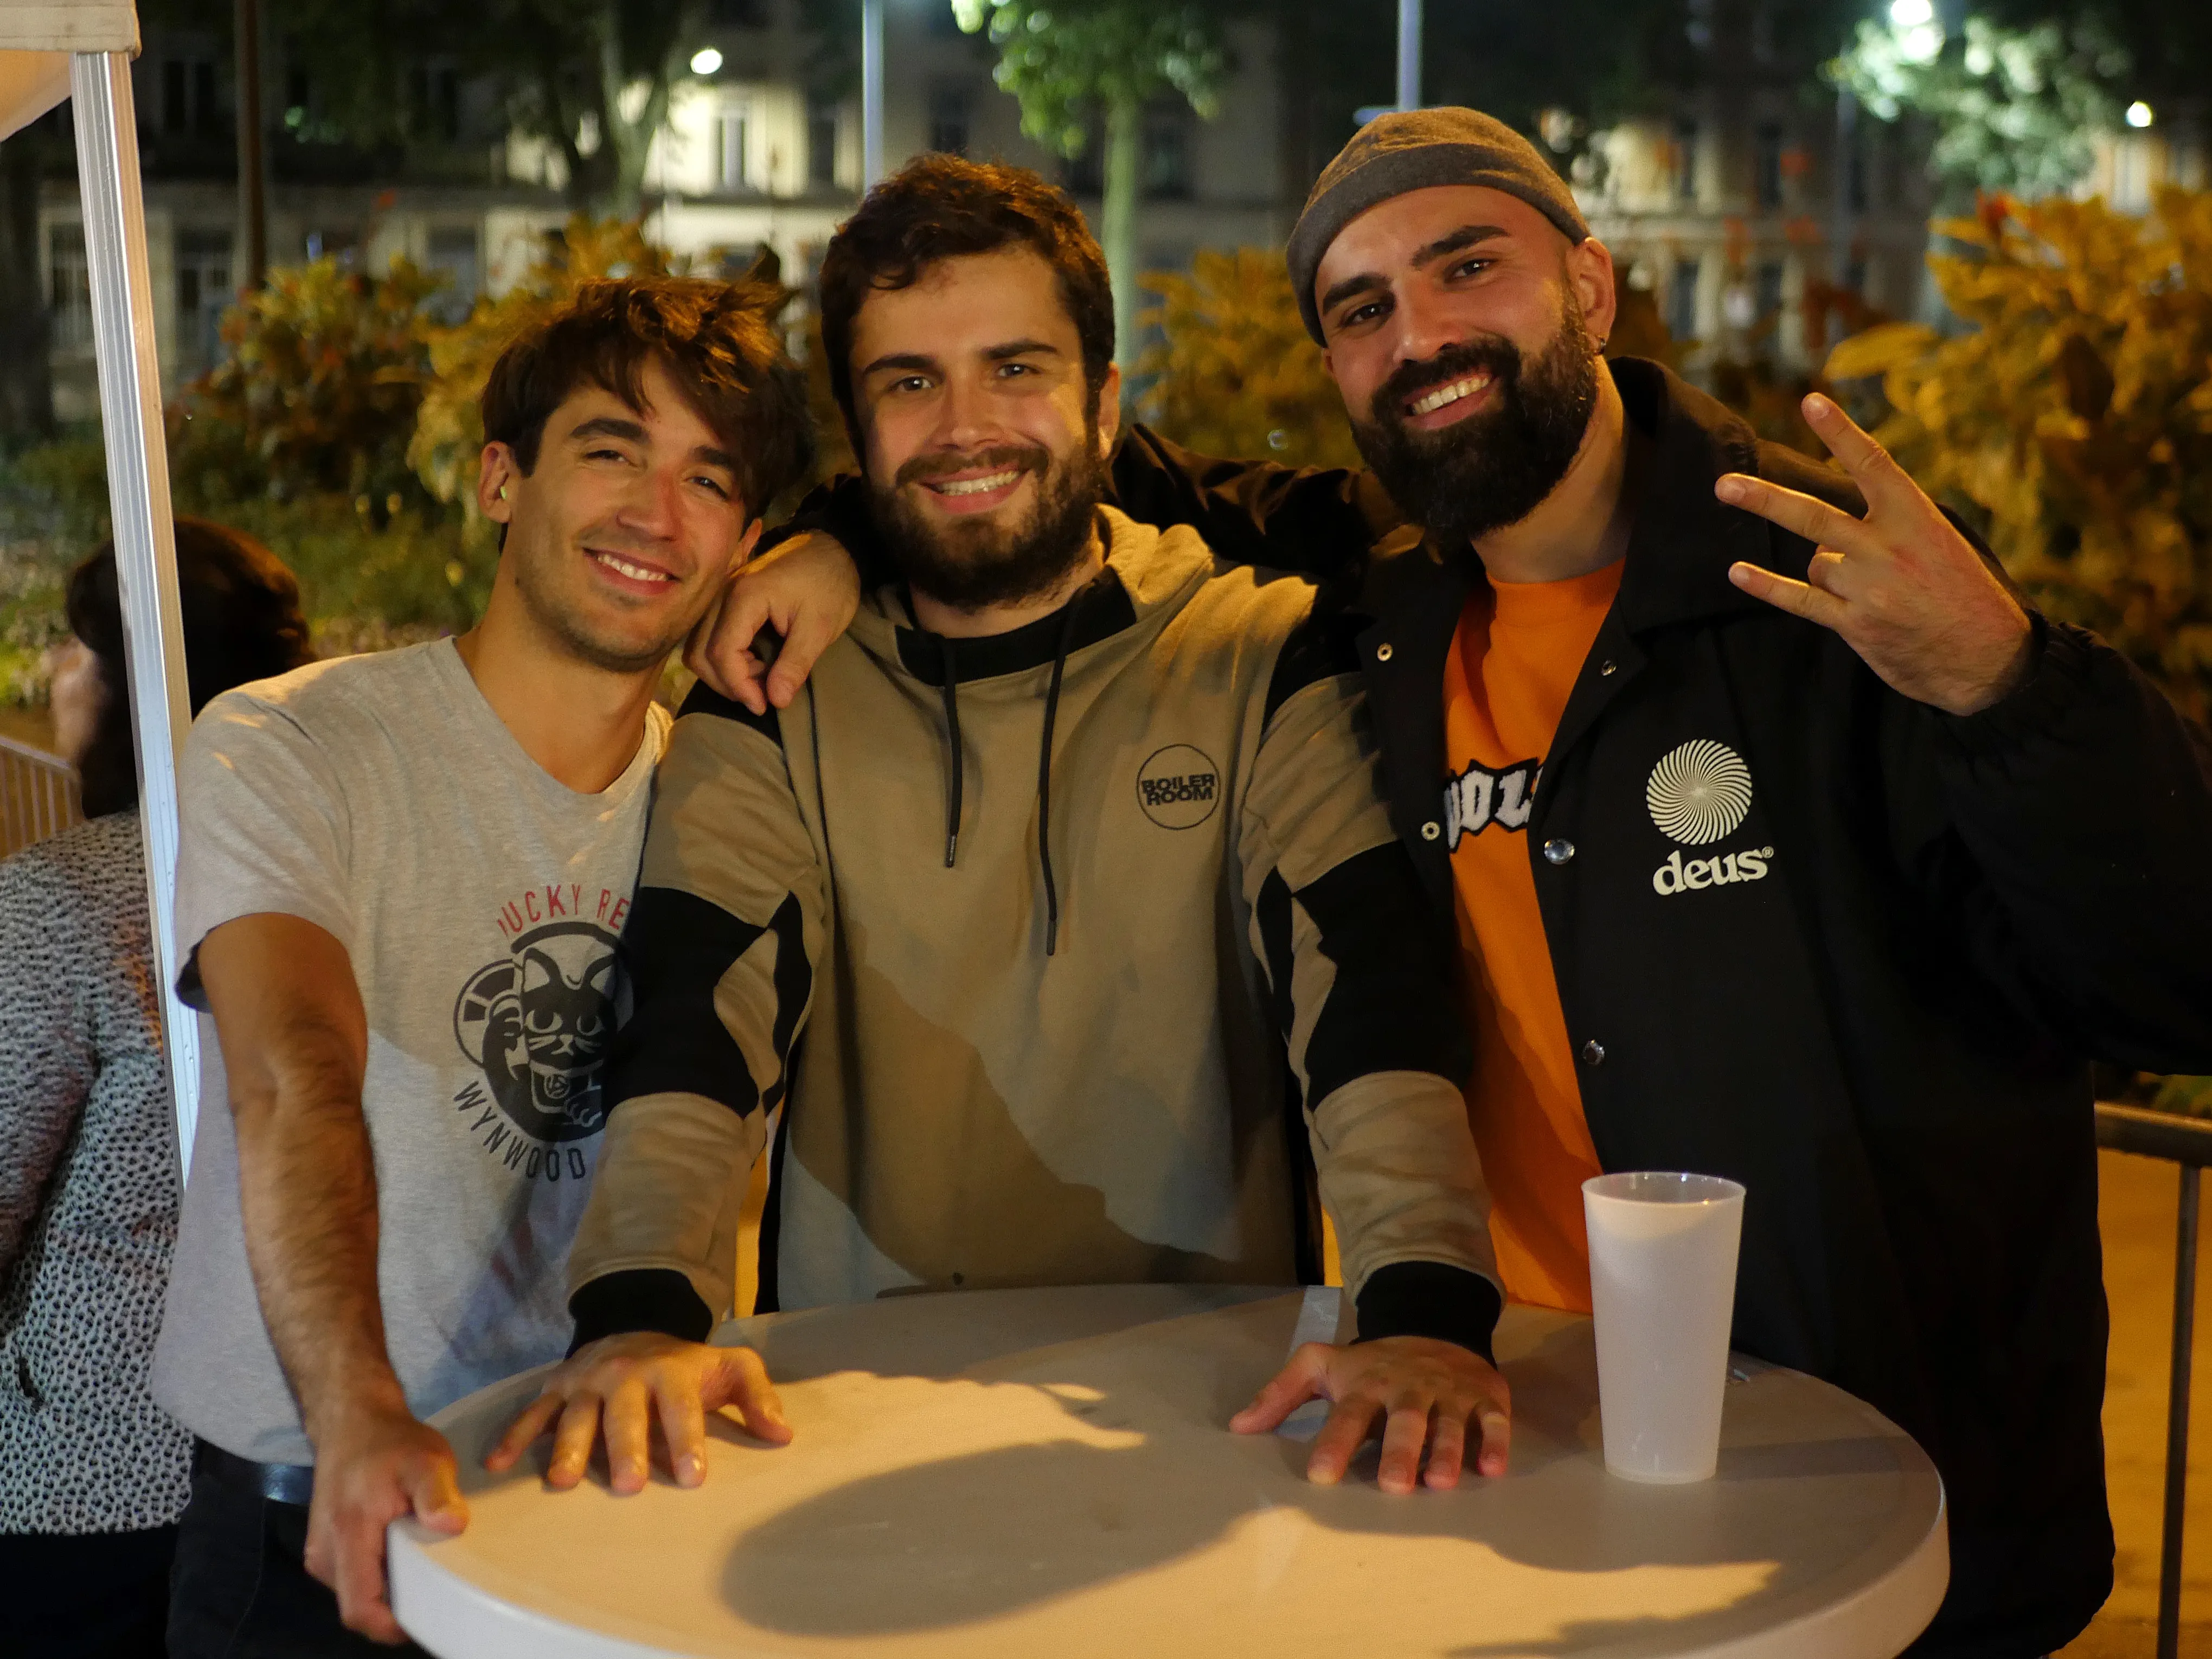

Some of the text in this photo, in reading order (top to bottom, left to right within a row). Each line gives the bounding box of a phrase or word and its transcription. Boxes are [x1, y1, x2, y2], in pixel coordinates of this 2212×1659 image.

[1142, 773, 1215, 793] BOILER
[1146, 785, 1213, 806] ROOM
[453, 1080, 586, 1182] WYNWOOD
